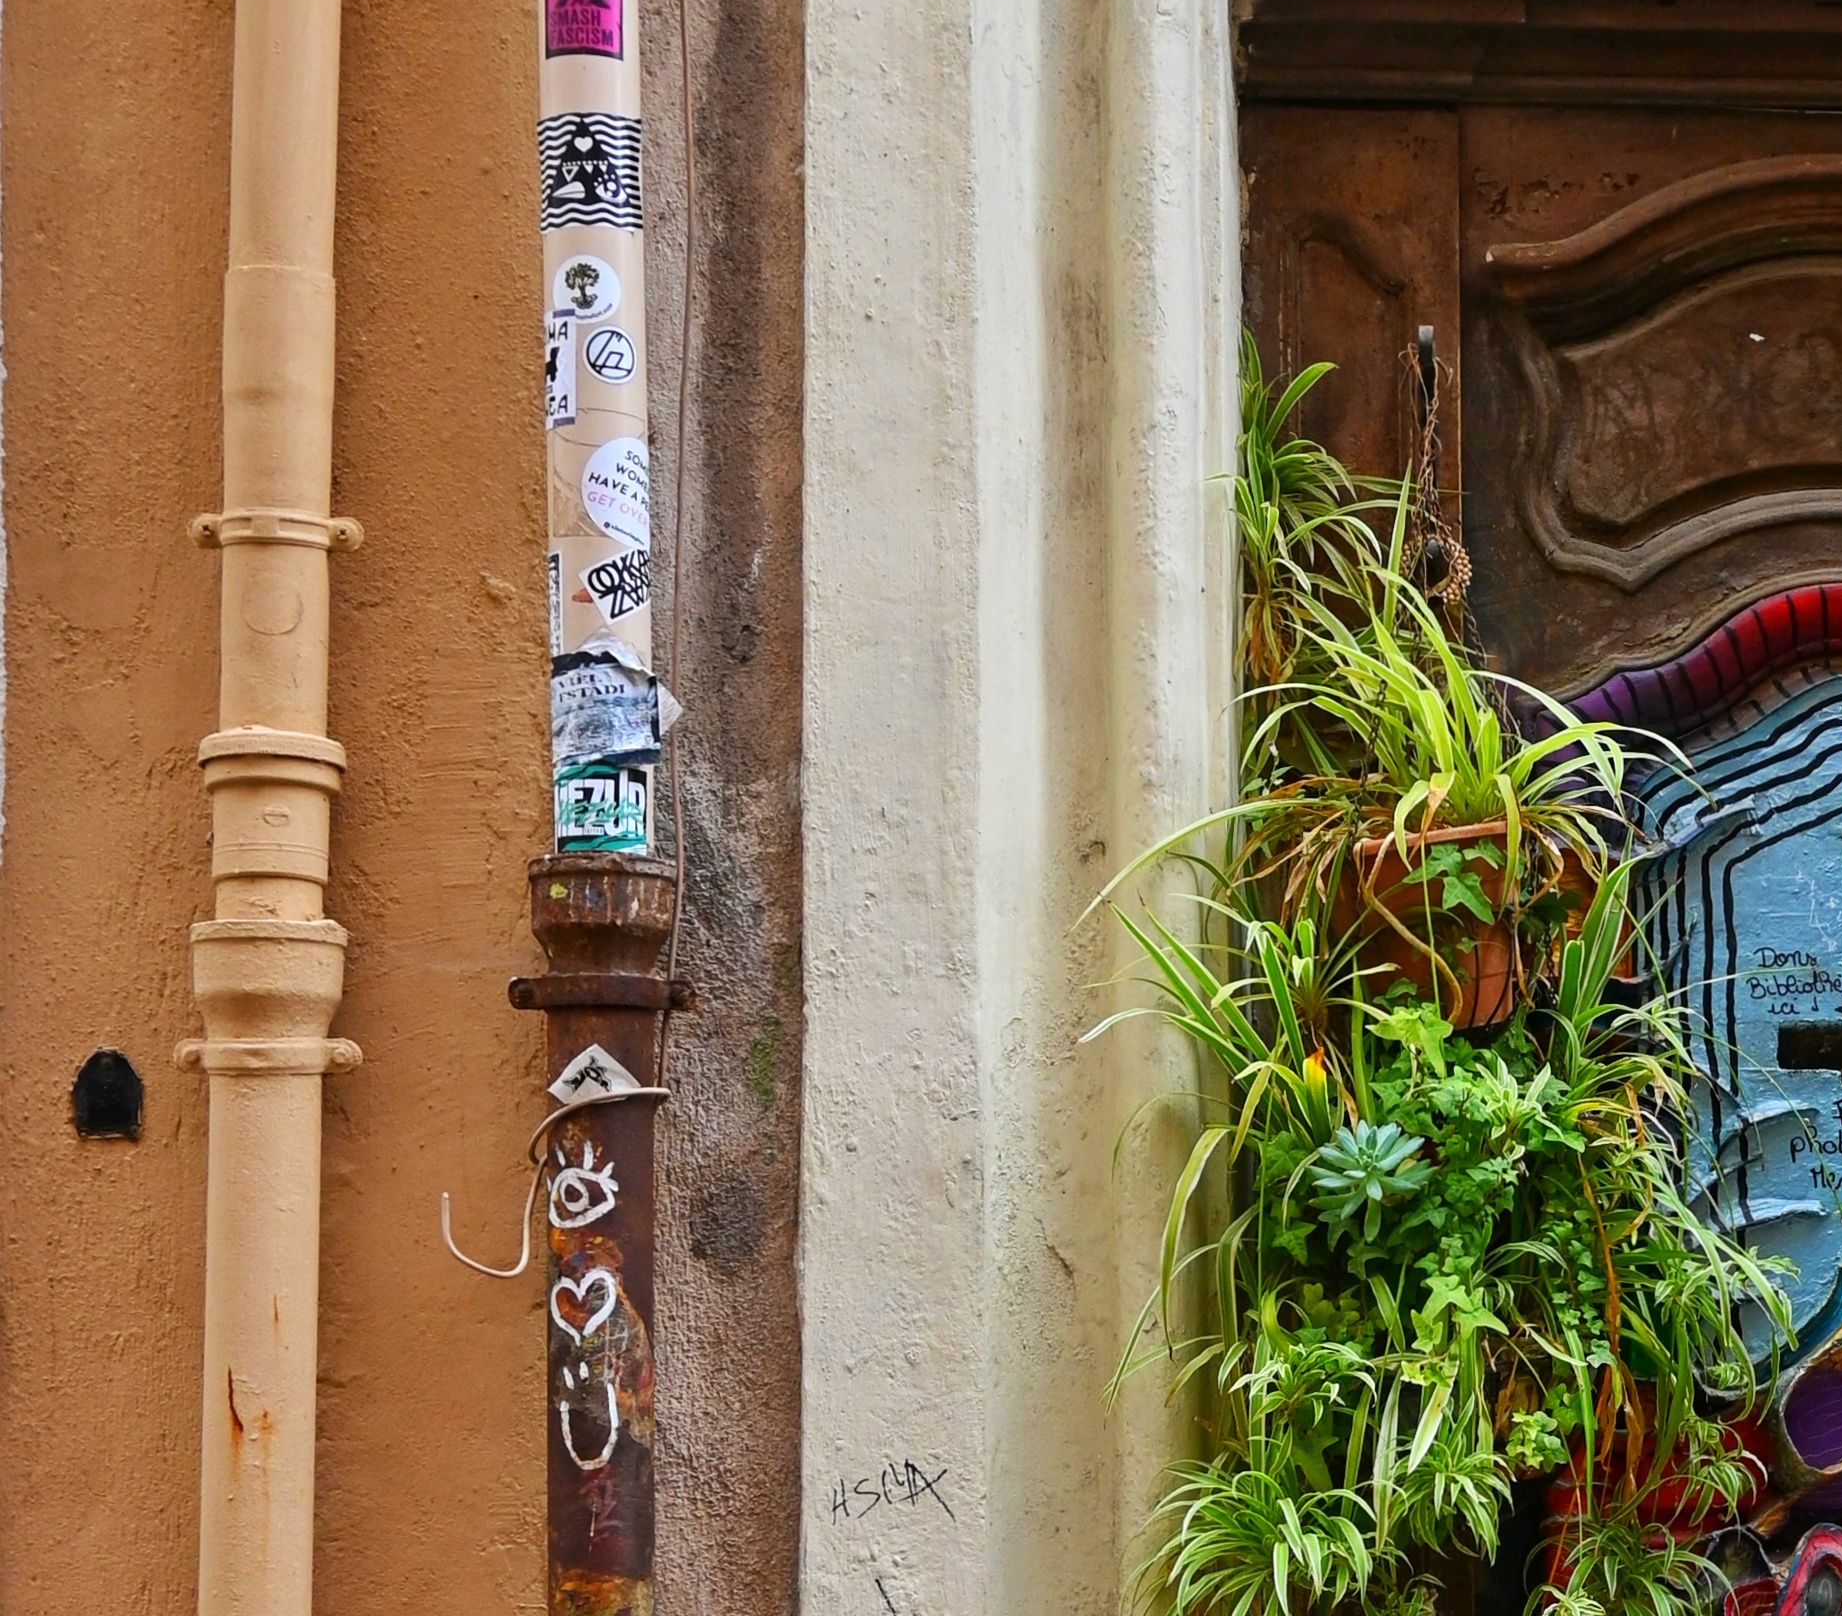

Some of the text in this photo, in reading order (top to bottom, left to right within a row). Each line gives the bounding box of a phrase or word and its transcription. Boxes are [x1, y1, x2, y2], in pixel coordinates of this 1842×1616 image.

[550, 8, 601, 28] SMASH
[550, 27, 614, 47] FASCISM
[624, 450, 647, 471] SOM
[588, 471, 630, 496] HAVE
[630, 491, 639, 502] A
[616, 462, 649, 494] WOME
[587, 490, 617, 509] GET
[1753, 946, 1818, 968] Dons
